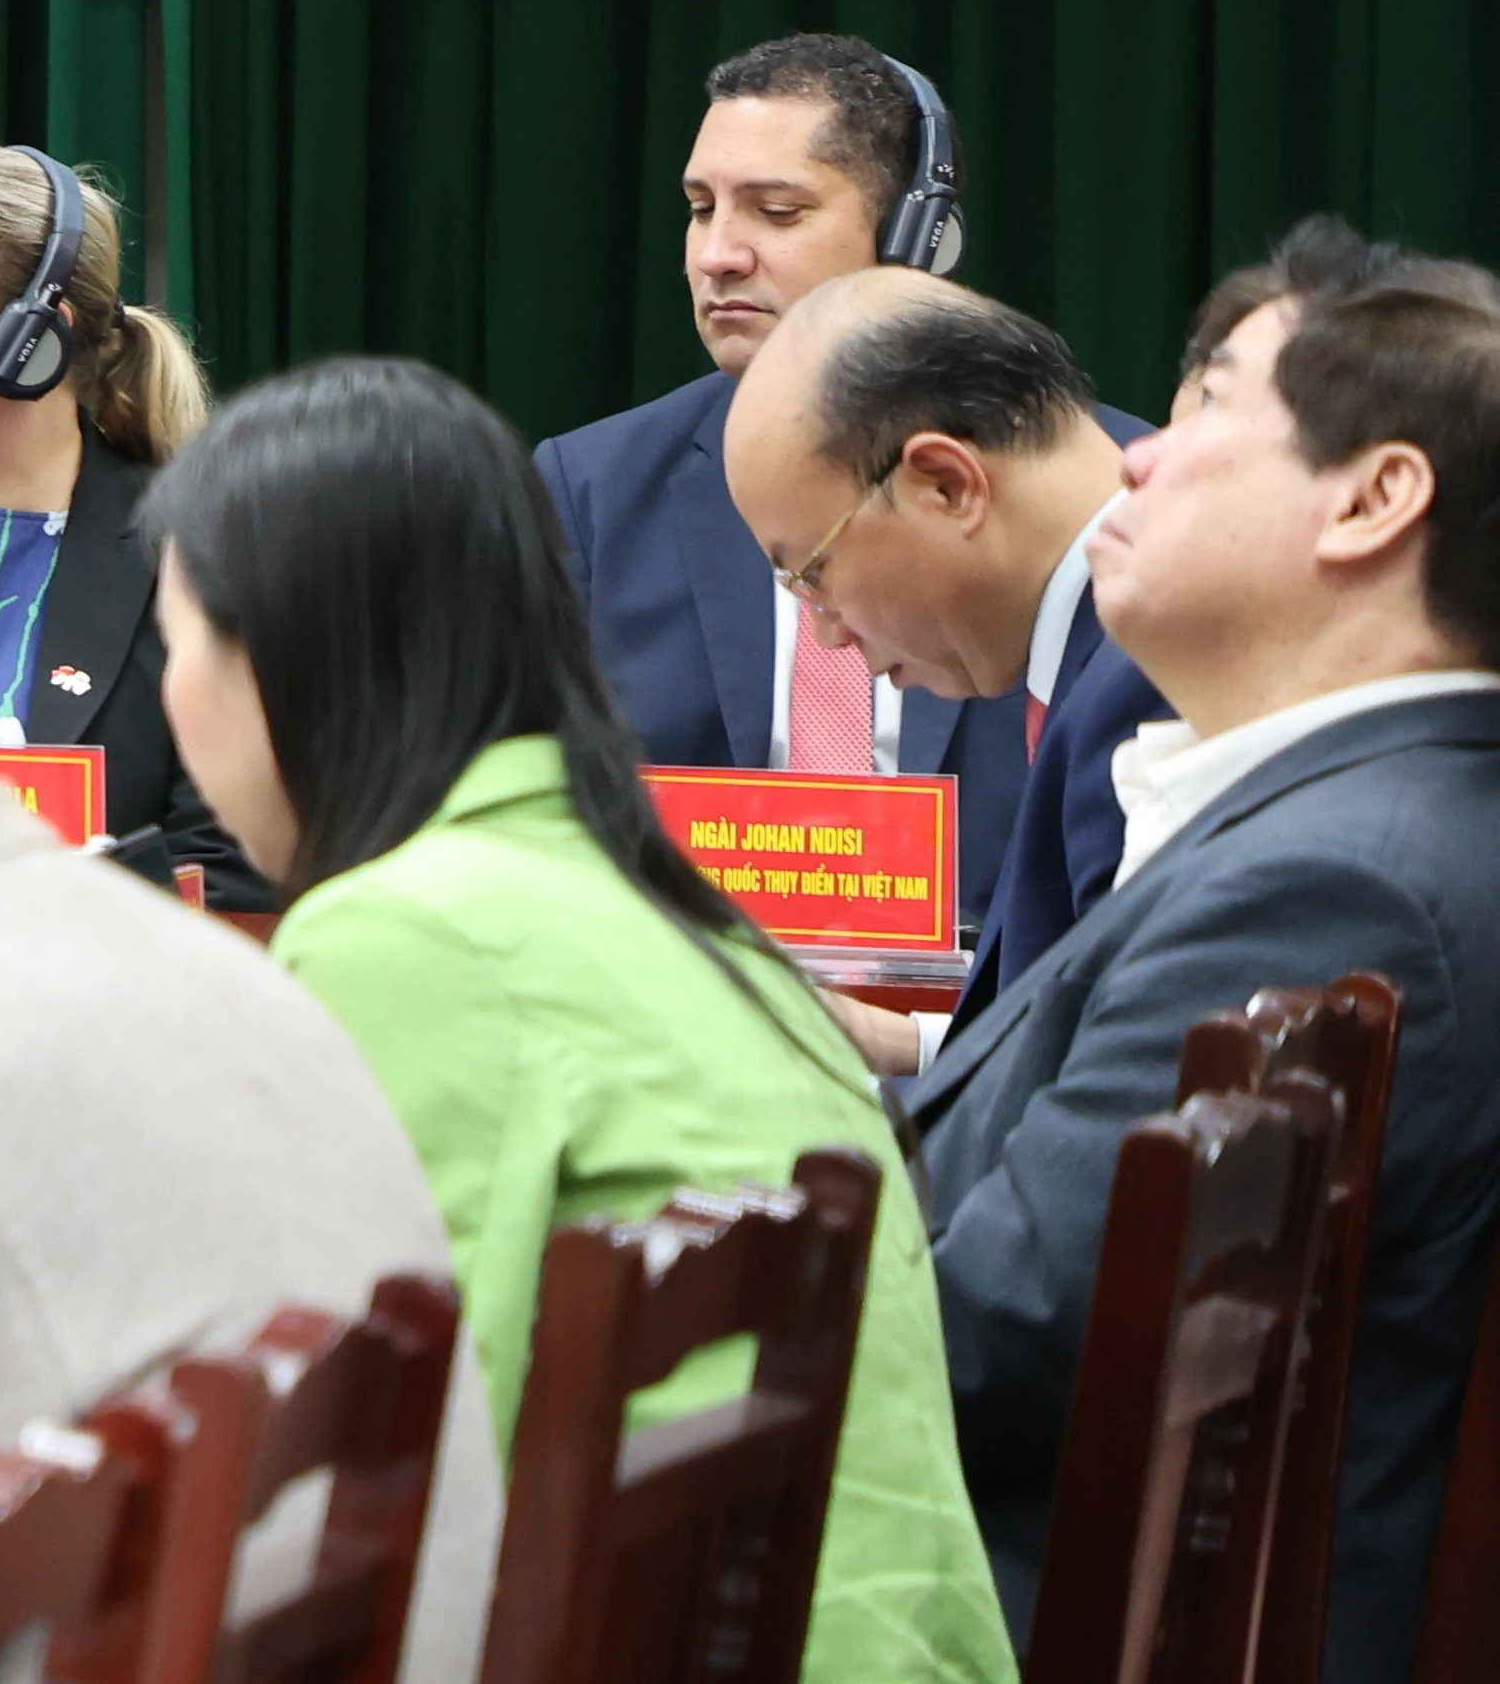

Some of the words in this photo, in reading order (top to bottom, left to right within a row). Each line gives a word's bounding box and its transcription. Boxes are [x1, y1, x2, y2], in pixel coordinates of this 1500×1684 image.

[689, 816, 738, 851] NGÀI
[740, 822, 806, 855] JOHAN
[809, 826, 864, 857] NDISI
[723, 860, 762, 894] QUỐC
[762, 868, 799, 900] THỤY
[800, 862, 835, 897] ĐIỂN
[837, 872, 860, 903] TẠI
[862, 868, 894, 904] VIỆT
[894, 876, 929, 902] NAM
